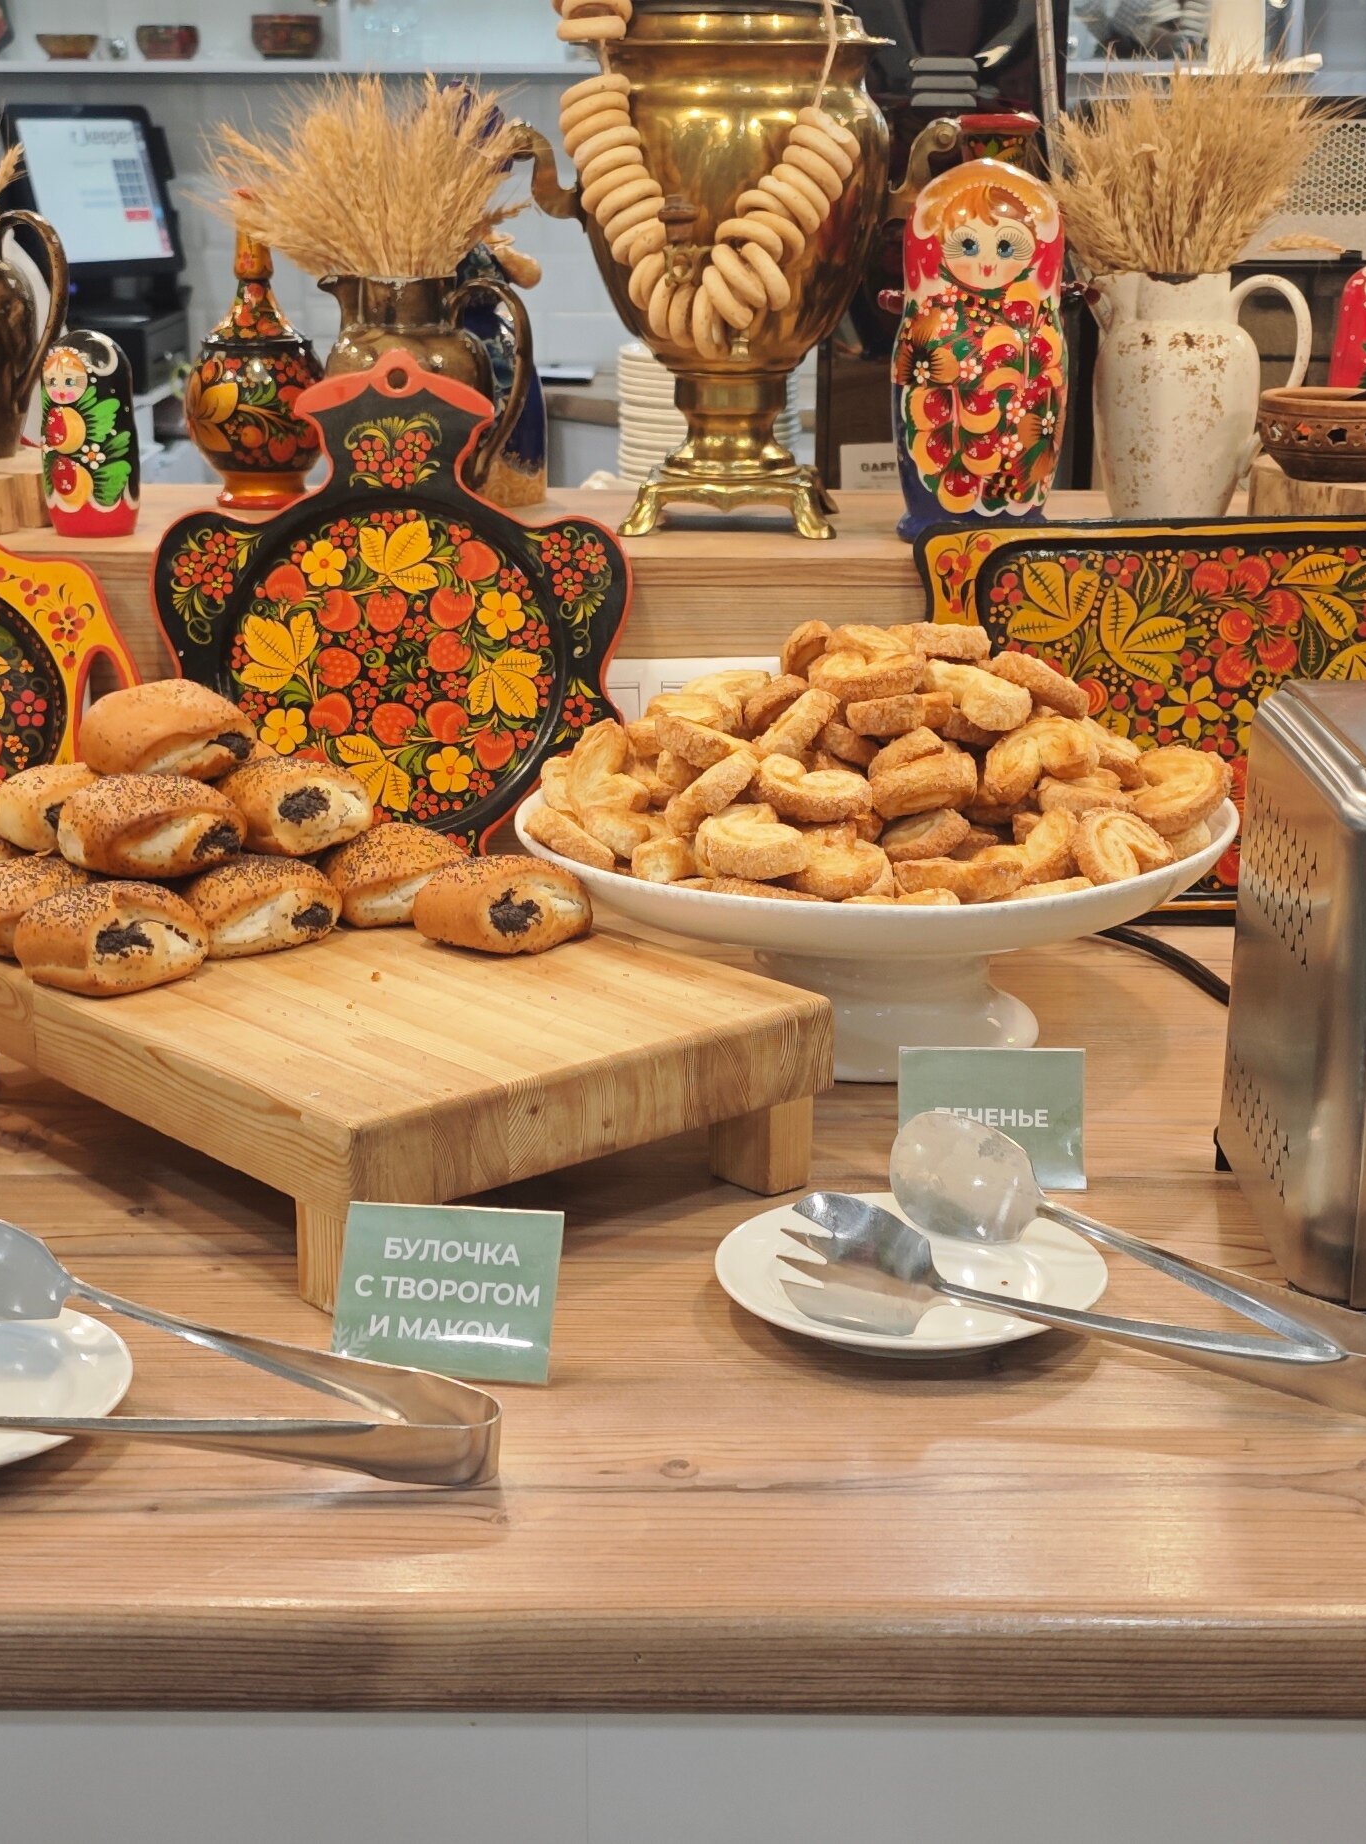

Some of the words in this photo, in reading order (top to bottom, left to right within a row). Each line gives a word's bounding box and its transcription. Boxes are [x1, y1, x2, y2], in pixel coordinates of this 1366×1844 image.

[934, 1106, 1049, 1128] ЧЕНЬЕ
[383, 1236, 521, 1267] БУЛОЧКА
[354, 1274, 375, 1298] С
[381, 1275, 541, 1308] ТВОРОГОМ
[368, 1314, 390, 1338] И
[397, 1316, 511, 1341] МАКОМ
